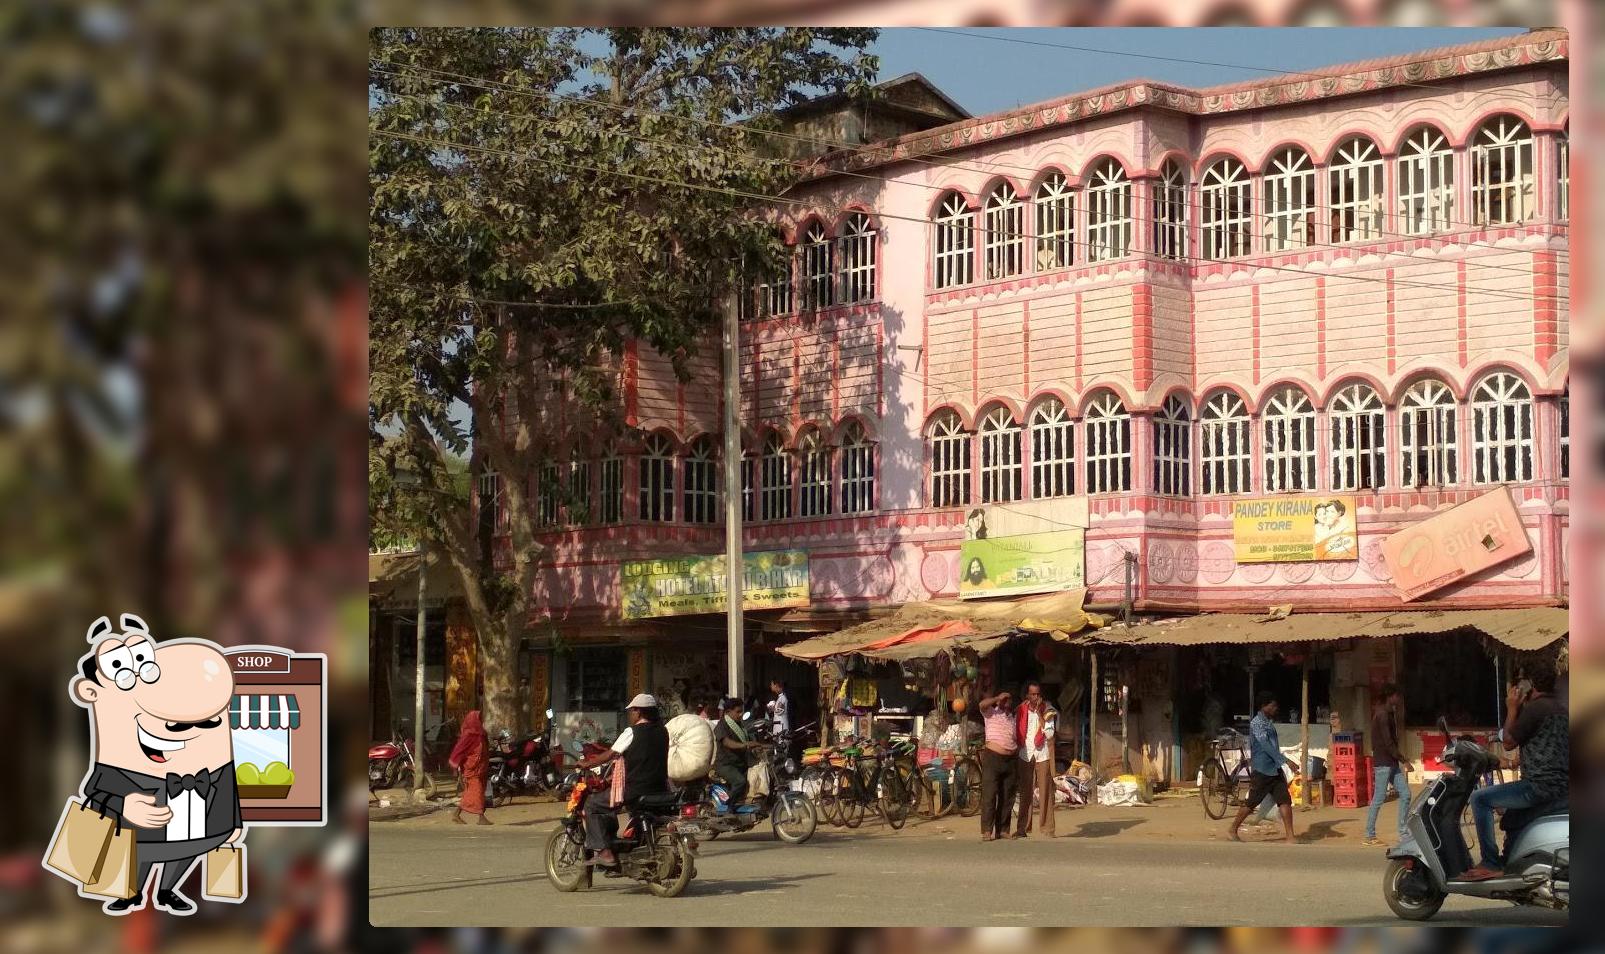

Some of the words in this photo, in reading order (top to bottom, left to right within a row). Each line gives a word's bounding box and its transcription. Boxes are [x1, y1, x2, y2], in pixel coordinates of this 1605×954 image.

[1235, 501, 1274, 518] PANDEY
[1276, 500, 1313, 517] KIRANA
[1258, 521, 1293, 531] STORE
[1446, 512, 1509, 556] airtel
[623, 560, 691, 576] LODGING
[655, 576, 701, 597] HOTEL
[756, 568, 803, 590] BIHAR
[702, 596, 728, 606] Tiffi
[752, 591, 799, 601] Sweets
